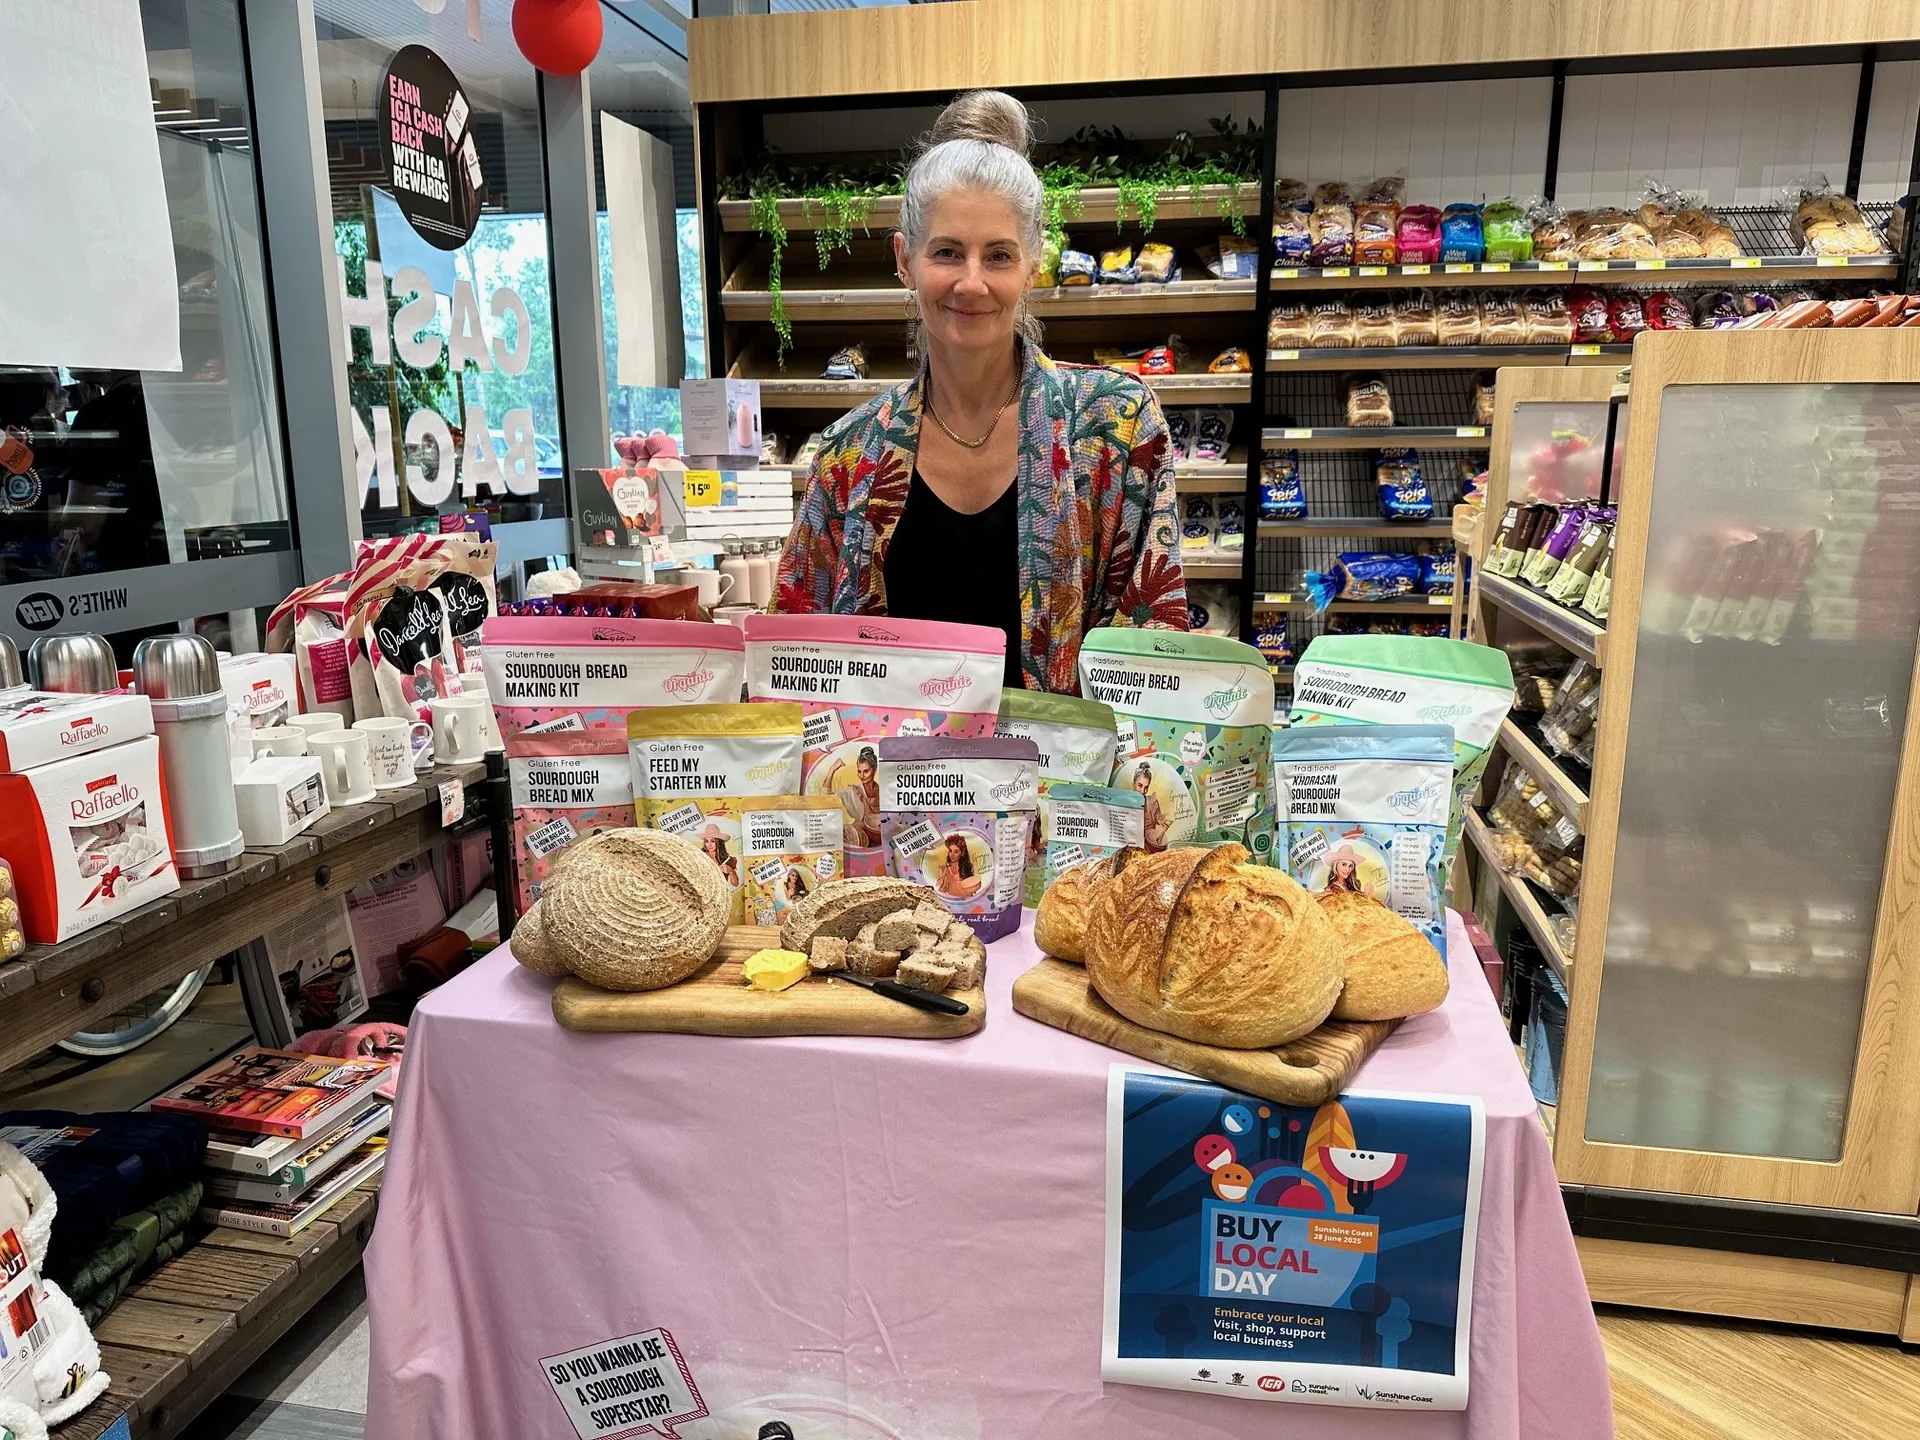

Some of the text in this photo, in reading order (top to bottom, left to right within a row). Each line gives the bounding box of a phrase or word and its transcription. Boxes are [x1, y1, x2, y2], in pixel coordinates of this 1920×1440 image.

[389, 74, 420, 107] EARN
[391, 98, 442, 138] IGA CASH
[392, 120, 424, 151] BACK
[392, 143, 445, 181] WITH IGA
[393, 170, 449, 203] REWARDS
[1527, 300, 1563, 312] WHITE
[1401, 334, 1430, 344] WHITE
[1447, 336, 1475, 345] WHITE
[1535, 335, 1564, 343] WHITE
[1268, 488, 1298, 497] Gold
[1395, 488, 1426, 498] Gold
[460, 588, 484, 616] Lea
[1257, 632, 1285, 641] Gold
[506, 651, 555, 659] Gluten Free
[772, 645, 820, 654] Gluten Free
[772, 657, 887, 678] SOURDOUGH BREAD
[1093, 656, 1125, 666] Traditional
[506, 664, 628, 678] SOURDOUGH BREAD
[1316, 667, 1351, 678] Traditional
[662, 670, 714, 693] Organic
[771, 675, 840, 694] MAKING KIT
[919, 676, 972, 696] Organic
[1089, 668, 1180, 691] SOURDOUGH BREAD
[506, 683, 580, 698] MAKING KIT
[1304, 676, 1406, 704] SOURDOUGH BREAD
[1124, 690, 1142, 706] KIT
[1204, 687, 1248, 709] Organic
[1297, 689, 1357, 709] MAKING KIT
[567, 720, 575, 728] BE
[804, 716, 823, 728] WANNA
[60, 724, 108, 745] Raffaello
[1118, 732, 1134, 744] MEAN
[650, 743, 704, 752] Gluten Free
[528, 759, 580, 768] Gluten Free
[650, 758, 699, 773] FEED MY
[528, 770, 599, 786] SOURDOUGH
[650, 775, 726, 790] STARTER MIX
[896, 774, 964, 788] SOURDOUGH
[1292, 775, 1337, 786] KHORASAN
[530, 788, 594, 802] BREAD MIX
[990, 780, 1030, 798] Organic
[1291, 788, 1340, 800] SOURDOUGH
[70, 784, 138, 820] Raffaello
[897, 792, 975, 806] FOCACCIA MIX
[1387, 786, 1438, 808] Organic
[1291, 803, 1336, 814] BREAD MIX
[660, 807, 692, 827] LET'S GET THIS
[679, 814, 700, 830] STARTED
[1057, 817, 1099, 828] SOURDOUGH
[529, 820, 563, 843] GLUTEN FREE
[539, 826, 569, 848] HOW BREAD'S
[752, 828, 794, 838] SOURDOUGH
[896, 825, 929, 845] GLUTEN FREE
[1057, 827, 1088, 838] STARTER
[541, 834, 572, 854] MEANT BE
[752, 840, 785, 850] STARTER
[908, 834, 934, 852] FABULOUS
[1308, 834, 1322, 847] WORLD
[1299, 851, 1311, 864] BETTER
[1311, 843, 1326, 857] PLACE
[88, 915, 98, 924] NET
[217, 1215, 241, 1224] HOUSE
[243, 1220, 264, 1228] STYLE
[1217, 1214, 1282, 1242] BUY
[1314, 1225, 1373, 1238] Sunshine Coast
[1324, 1234, 1342, 1243] June
[1344, 1236, 1362, 1245] 2025
[1215, 1241, 1318, 1274] LOCAL
[1214, 1268, 1278, 1296] DAY
[1214, 1307, 1324, 1326] Embrace your local
[1214, 1319, 1326, 1340] Visit, shop, support
[1213, 1330, 1294, 1349] local business
[549, 1337, 666, 1385] SO YOU WANNA BE
[575, 1367, 665, 1406] A SOURDOUGH
[1260, 1378, 1282, 1390] IGA
[1308, 1384, 1340, 1392] sunshine
[1375, 1391, 1433, 1403] Sunshine Coast
[590, 1393, 673, 1429] SUPERSTAR?
